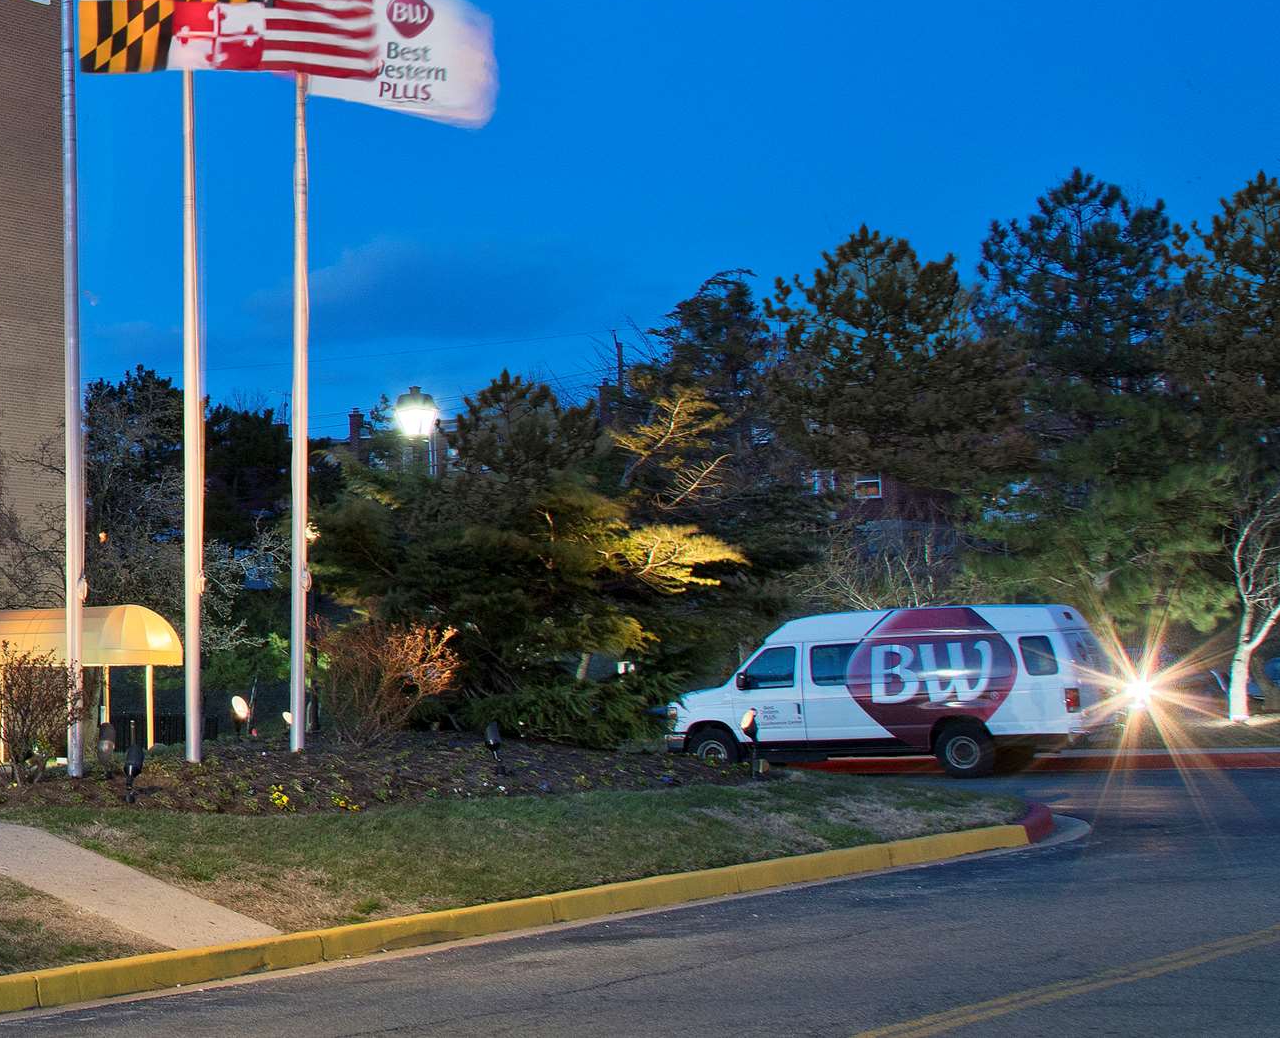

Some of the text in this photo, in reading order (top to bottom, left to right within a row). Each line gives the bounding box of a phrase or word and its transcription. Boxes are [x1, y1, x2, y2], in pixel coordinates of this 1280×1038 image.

[392, 2, 429, 25] BW
[386, 42, 432, 62] Best
[379, 81, 433, 101] PLUS
[870, 639, 993, 705] BW
